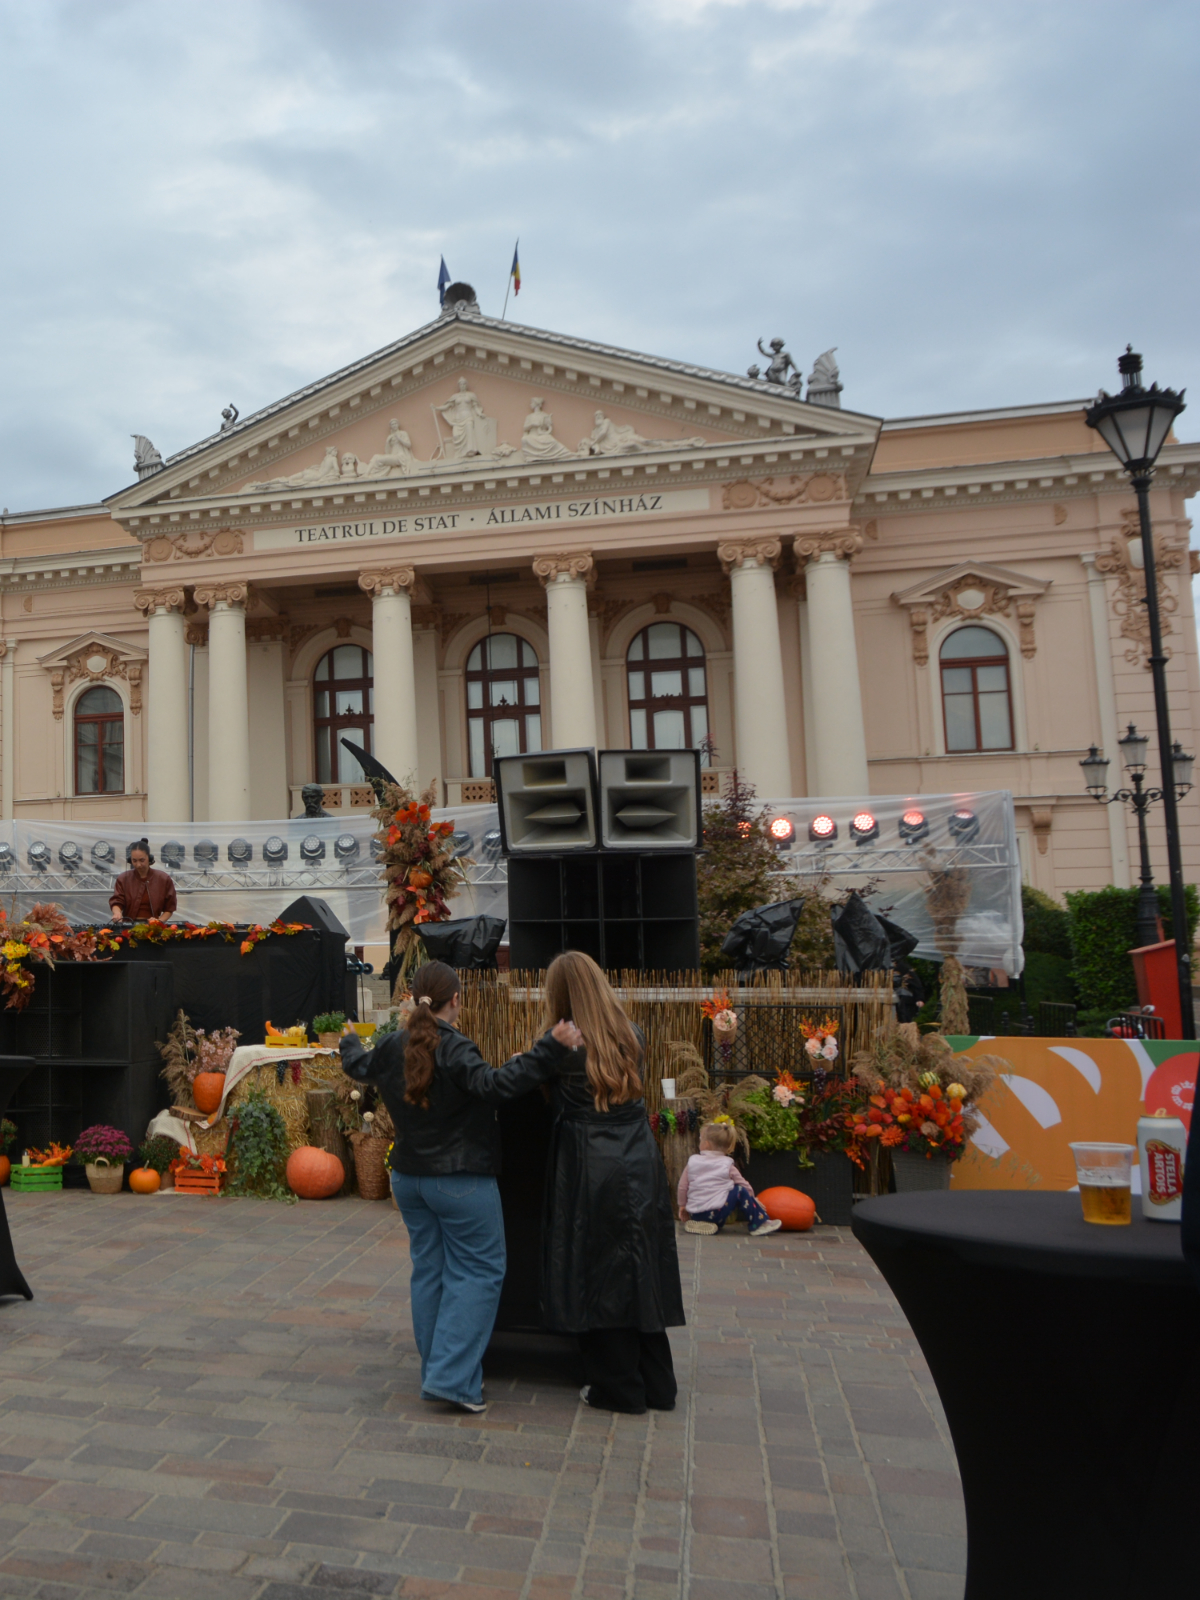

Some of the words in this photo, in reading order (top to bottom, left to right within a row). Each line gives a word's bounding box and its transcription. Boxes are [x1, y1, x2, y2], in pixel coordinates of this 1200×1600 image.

[295, 521, 378, 543] TEATRUL
[383, 518, 408, 535] DE
[414, 513, 460, 532] STAT
[486, 506, 561, 526] ÁLLAMI
[567, 494, 663, 518] SZÍNHÁZ
[1153, 1152, 1167, 1194] ARTOIS
[1164, 1153, 1177, 1193] STELLA
